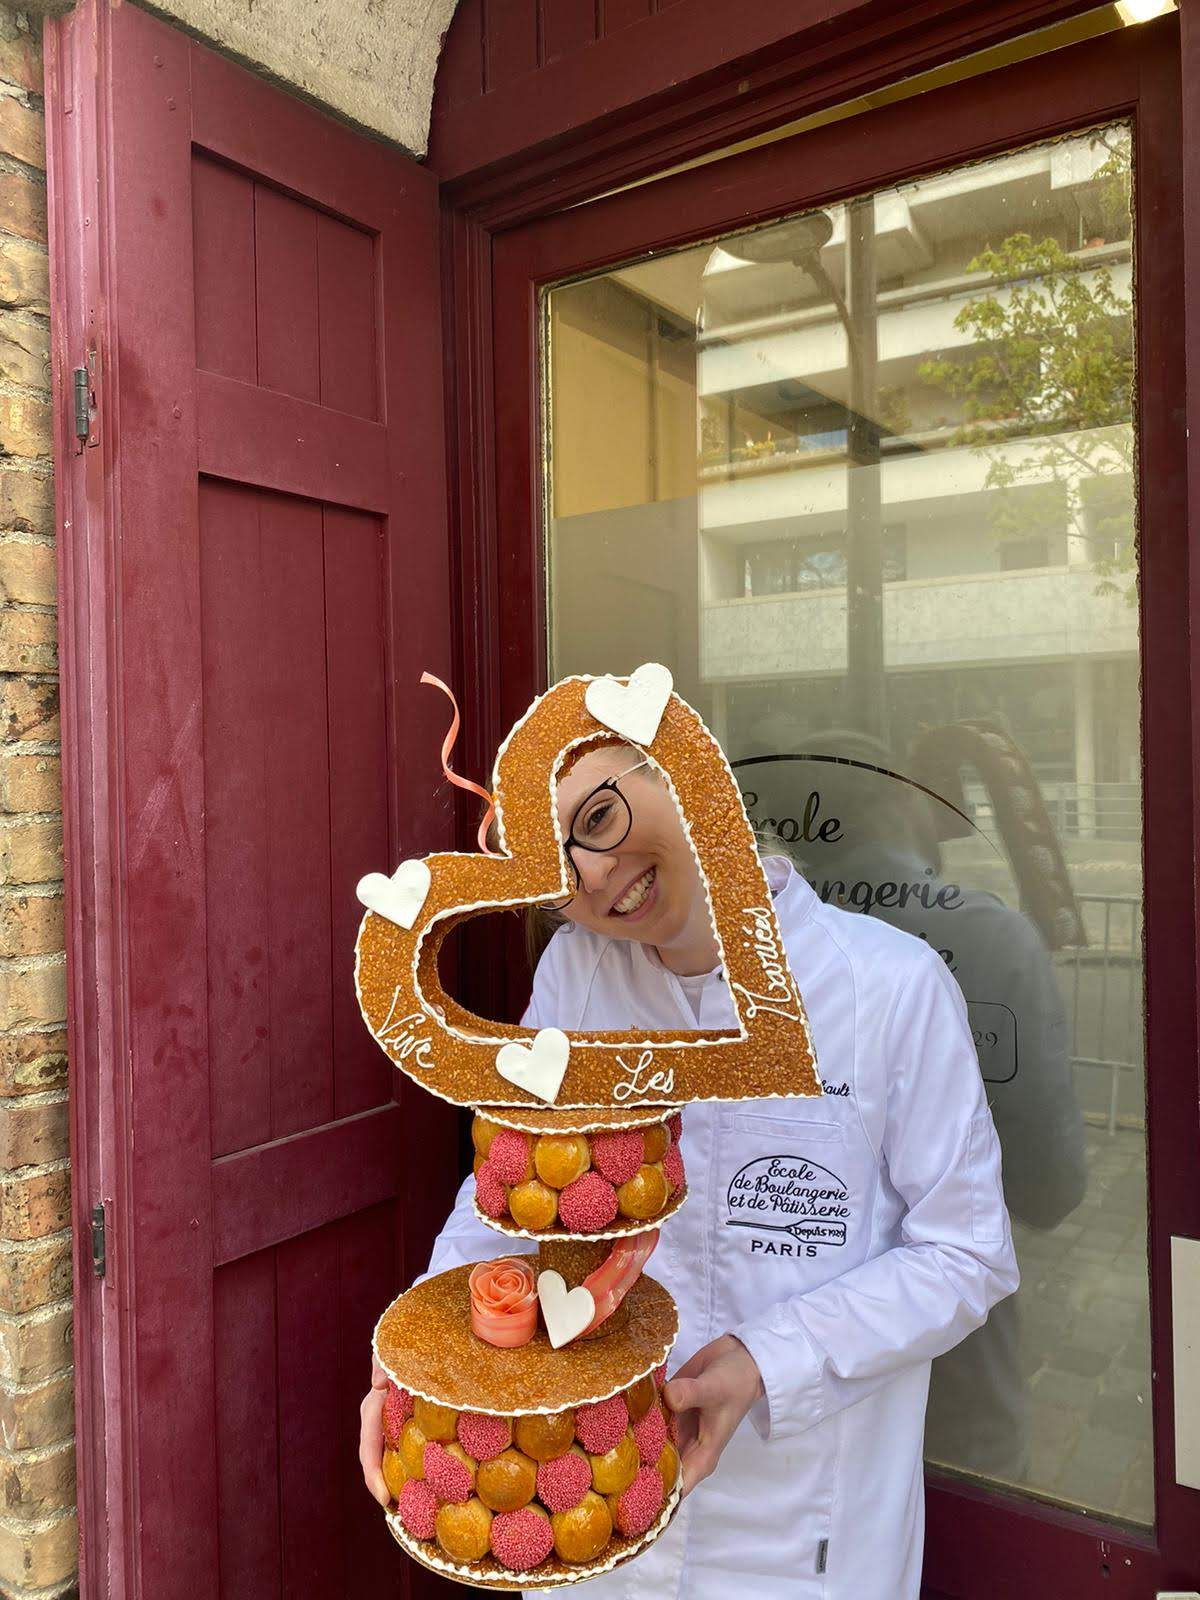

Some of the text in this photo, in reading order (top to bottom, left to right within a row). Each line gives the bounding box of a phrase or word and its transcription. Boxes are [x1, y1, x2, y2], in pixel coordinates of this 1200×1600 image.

[808, 867, 965, 914] ngerie
[375, 907, 799, 1100] Vive Les Mariés
[972, 1030, 998, 1048] 29
[768, 1159, 816, 1181] Ecole
[735, 1173, 849, 1204] de Boulangerie
[730, 1193, 850, 1218] et de Pâtisserie
[794, 1226, 827, 1240] Depuis
[751, 1240, 818, 1257] PARIS
